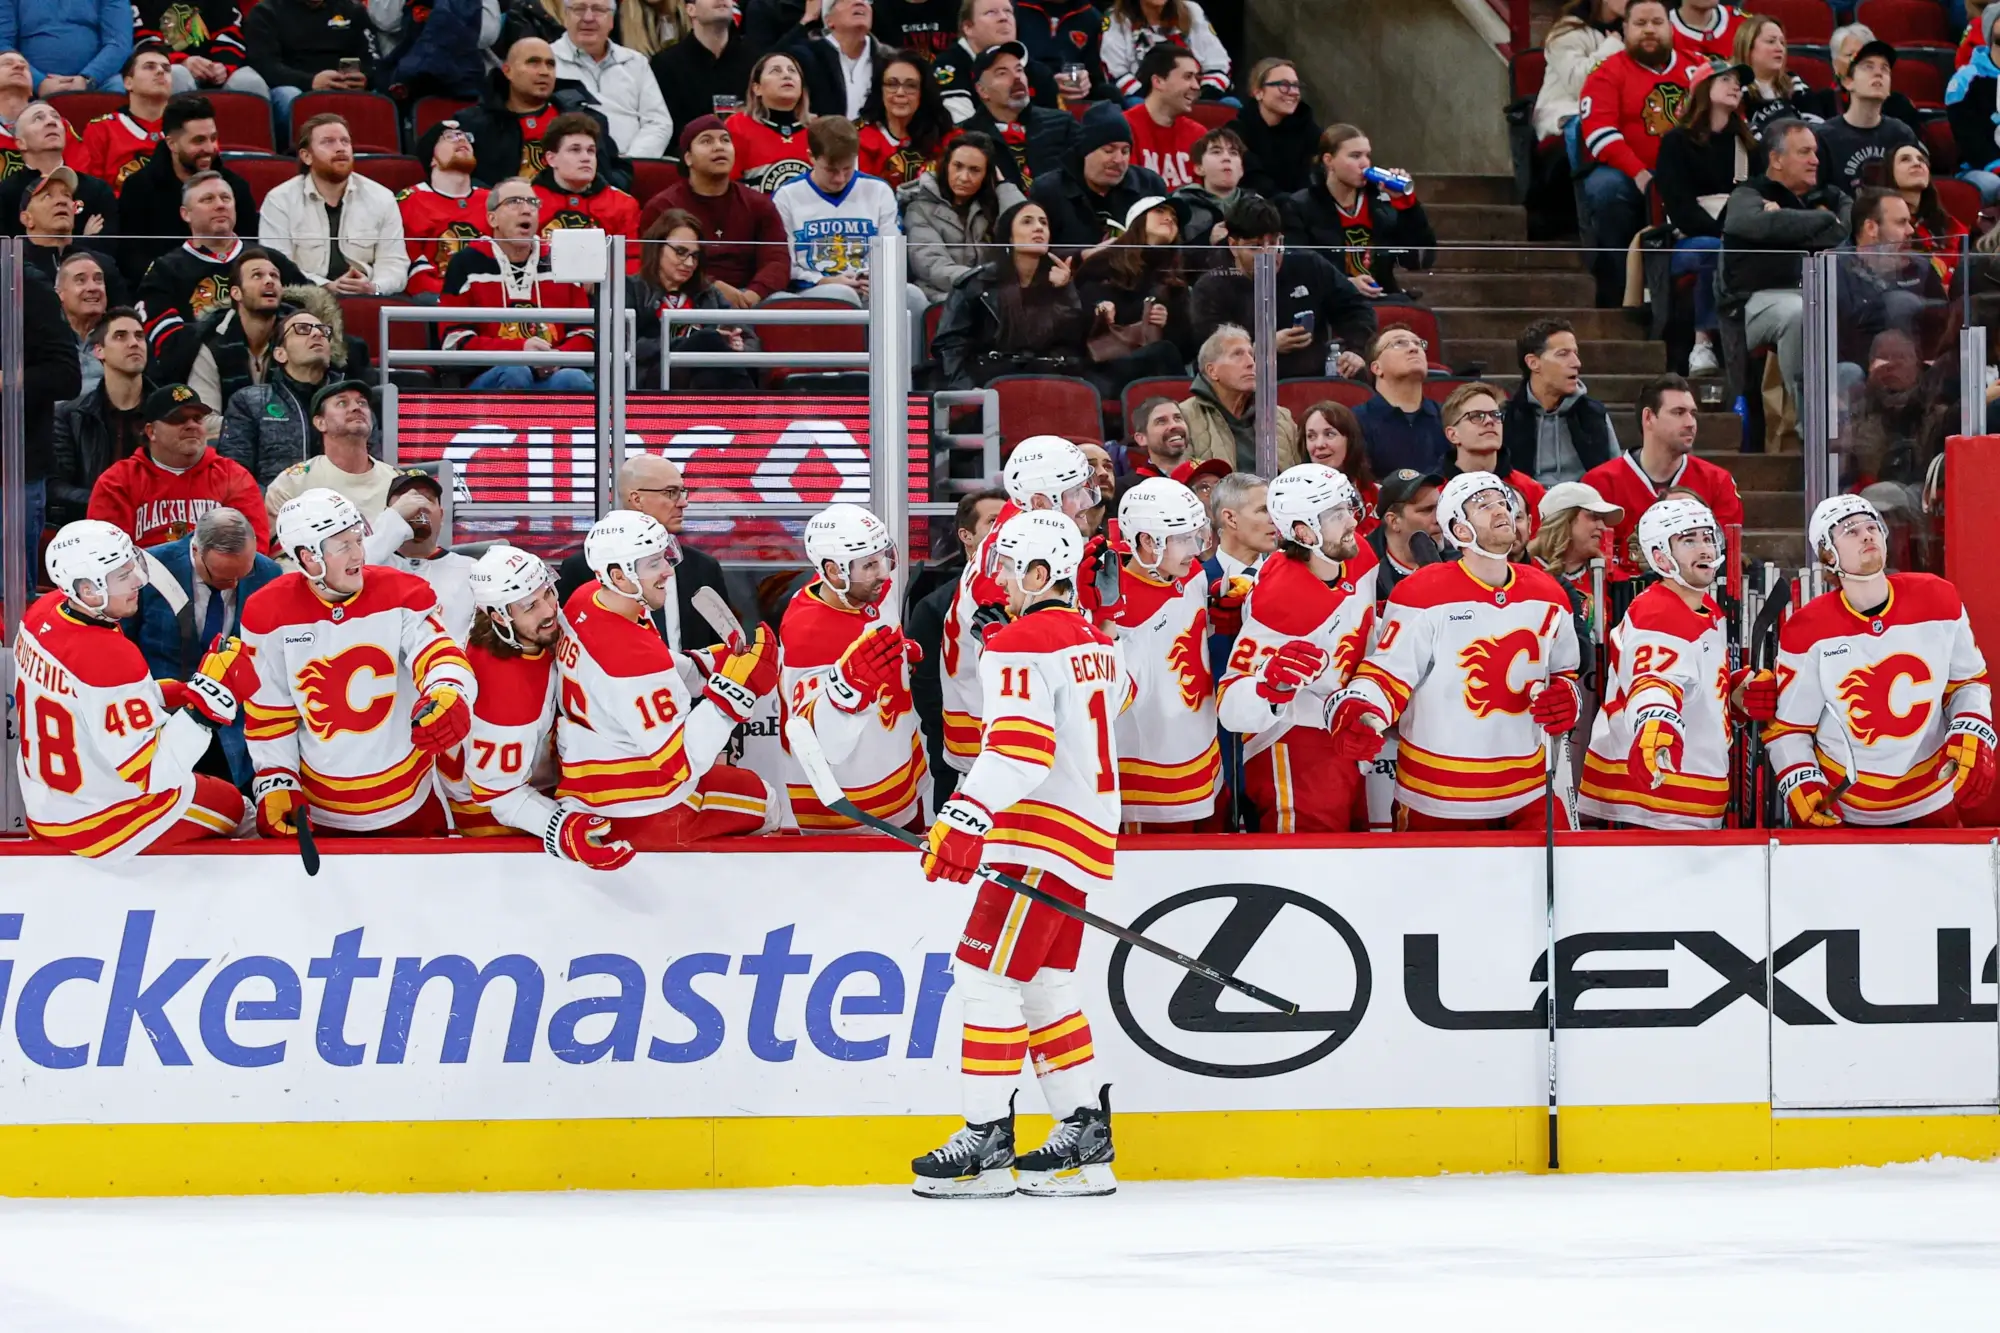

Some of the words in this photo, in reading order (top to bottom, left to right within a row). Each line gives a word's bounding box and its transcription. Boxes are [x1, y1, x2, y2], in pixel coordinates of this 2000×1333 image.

[807, 221, 869, 236] SUOMI
[1012, 453, 1043, 464] TELUS
[1276, 476, 1301, 484] TELUS
[1129, 493, 1156, 501] TELUS
[136, 499, 222, 541] BLACKHAW
[811, 521, 836, 529] TELUS
[1033, 518, 1066, 529] TELUS
[596, 527, 625, 536] TELUS
[53, 538, 81, 551] TELUS
[506, 554, 524, 568] 70
[1449, 614, 1473, 622] SUNCOR
[285, 636, 312, 644] SUNCOR
[1633, 645, 1679, 676] 27
[1823, 648, 1849, 658] SUNCOR
[190, 675, 236, 710] CCM
[711, 675, 755, 710] CCM
[829, 668, 854, 699] CC
[999, 666, 1032, 701] 11
[104, 698, 157, 738] 48
[635, 687, 679, 732] 16
[1948, 719, 1996, 746] AUER
[473, 738, 523, 774] 70
[940, 804, 988, 833] CCM
[546, 808, 566, 858] ARRIOR
[982, 1147, 1010, 1169] CM
